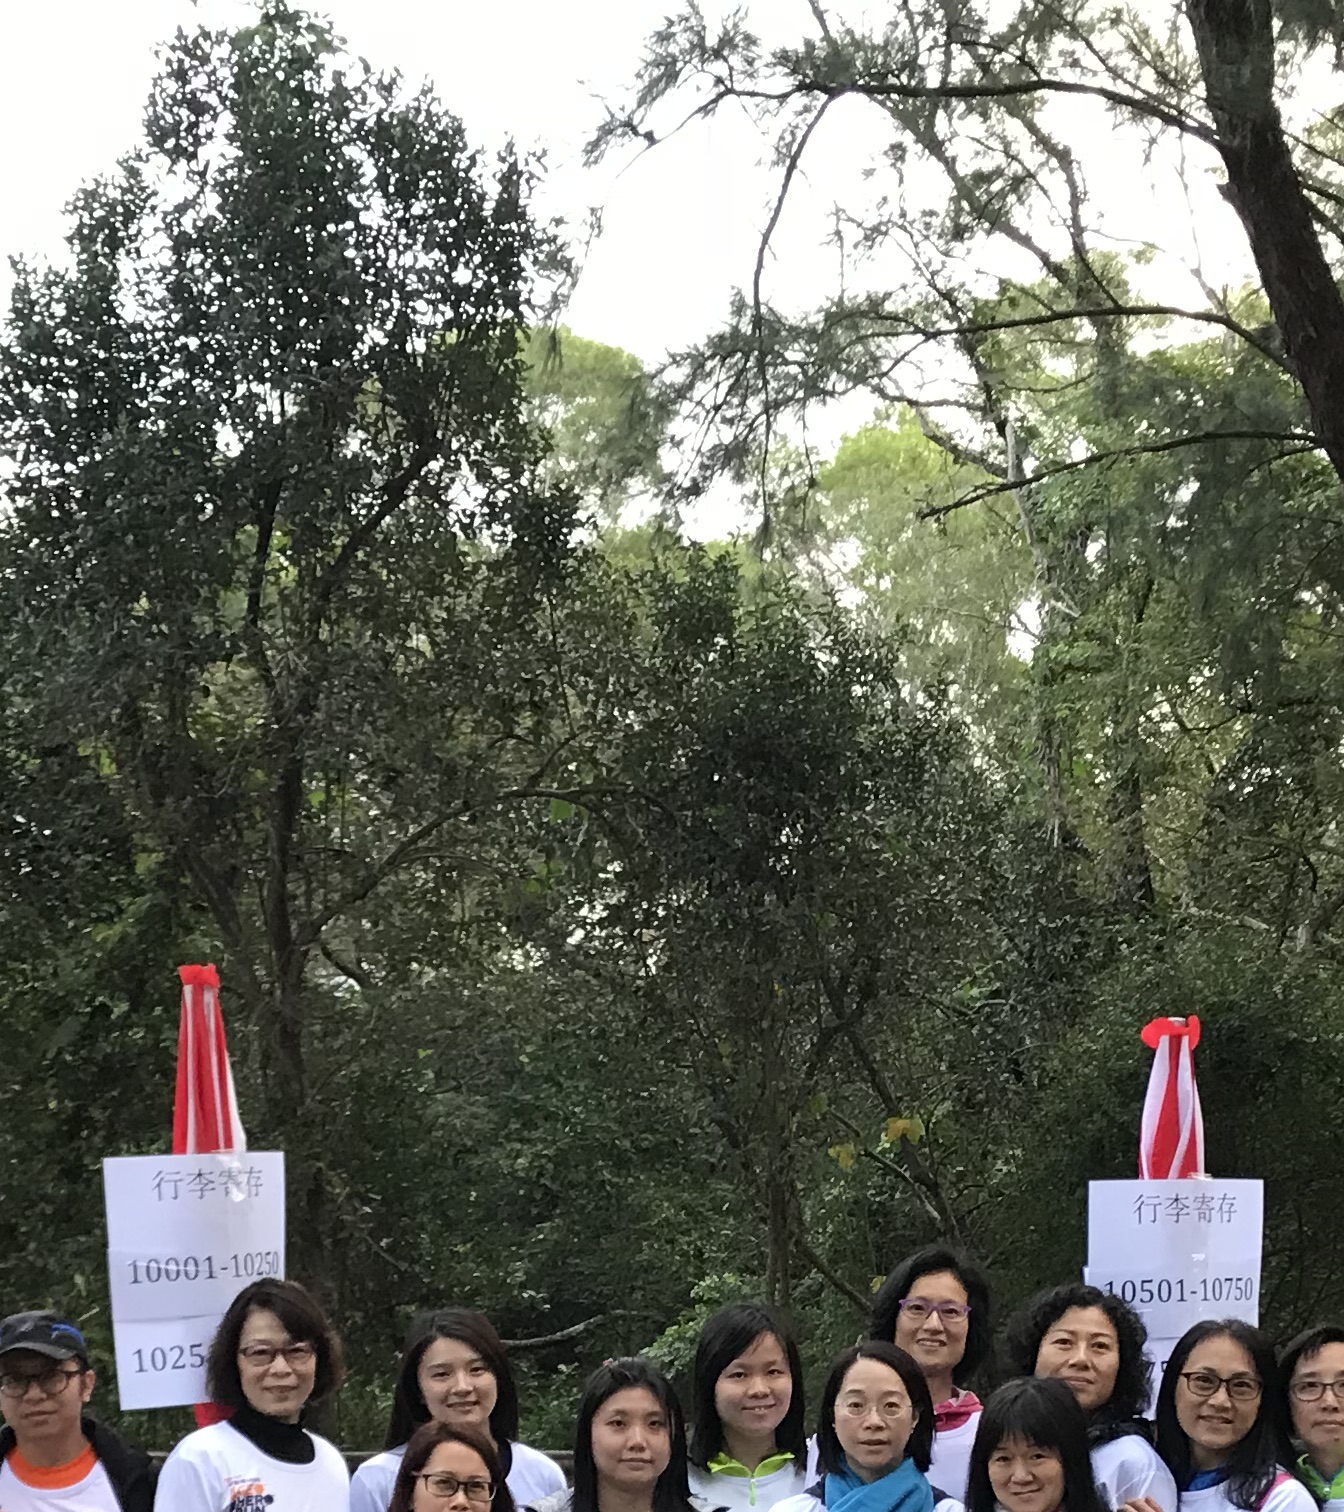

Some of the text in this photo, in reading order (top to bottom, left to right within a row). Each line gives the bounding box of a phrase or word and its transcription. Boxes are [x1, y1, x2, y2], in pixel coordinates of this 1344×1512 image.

[1133, 1192, 1238, 1225] 行李寄存
[127, 1250, 280, 1285] 10001-10250
[1104, 1276, 1254, 1304] 10501-10750
[132, 1343, 205, 1374] 1025
